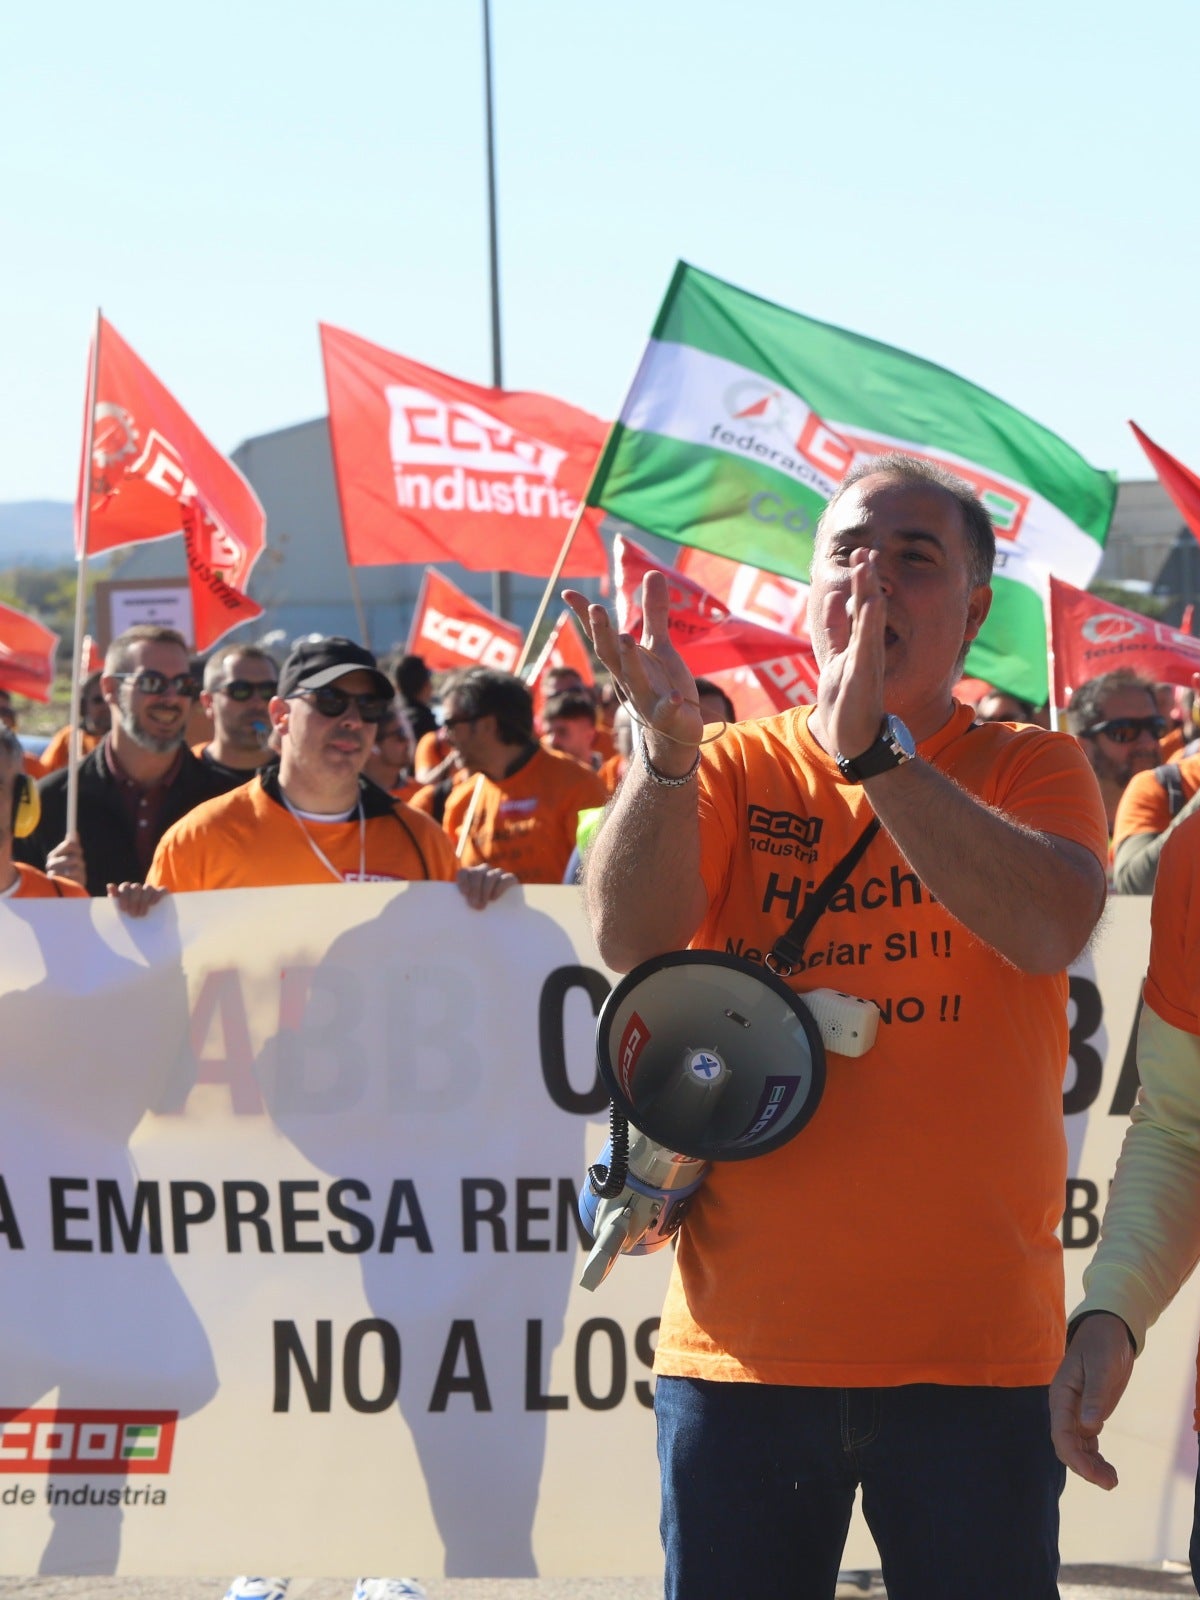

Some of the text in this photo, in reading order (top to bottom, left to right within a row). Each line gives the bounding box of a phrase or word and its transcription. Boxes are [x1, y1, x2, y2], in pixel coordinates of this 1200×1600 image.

[395, 463, 580, 520] industria
[750, 836, 818, 864] ndustria
[884, 930, 918, 962] SI
[49, 1176, 434, 1254] EMPRESA
[271, 1318, 403, 1413] NO
[427, 1318, 494, 1413] A
[1, 1484, 167, 1507] de industria
